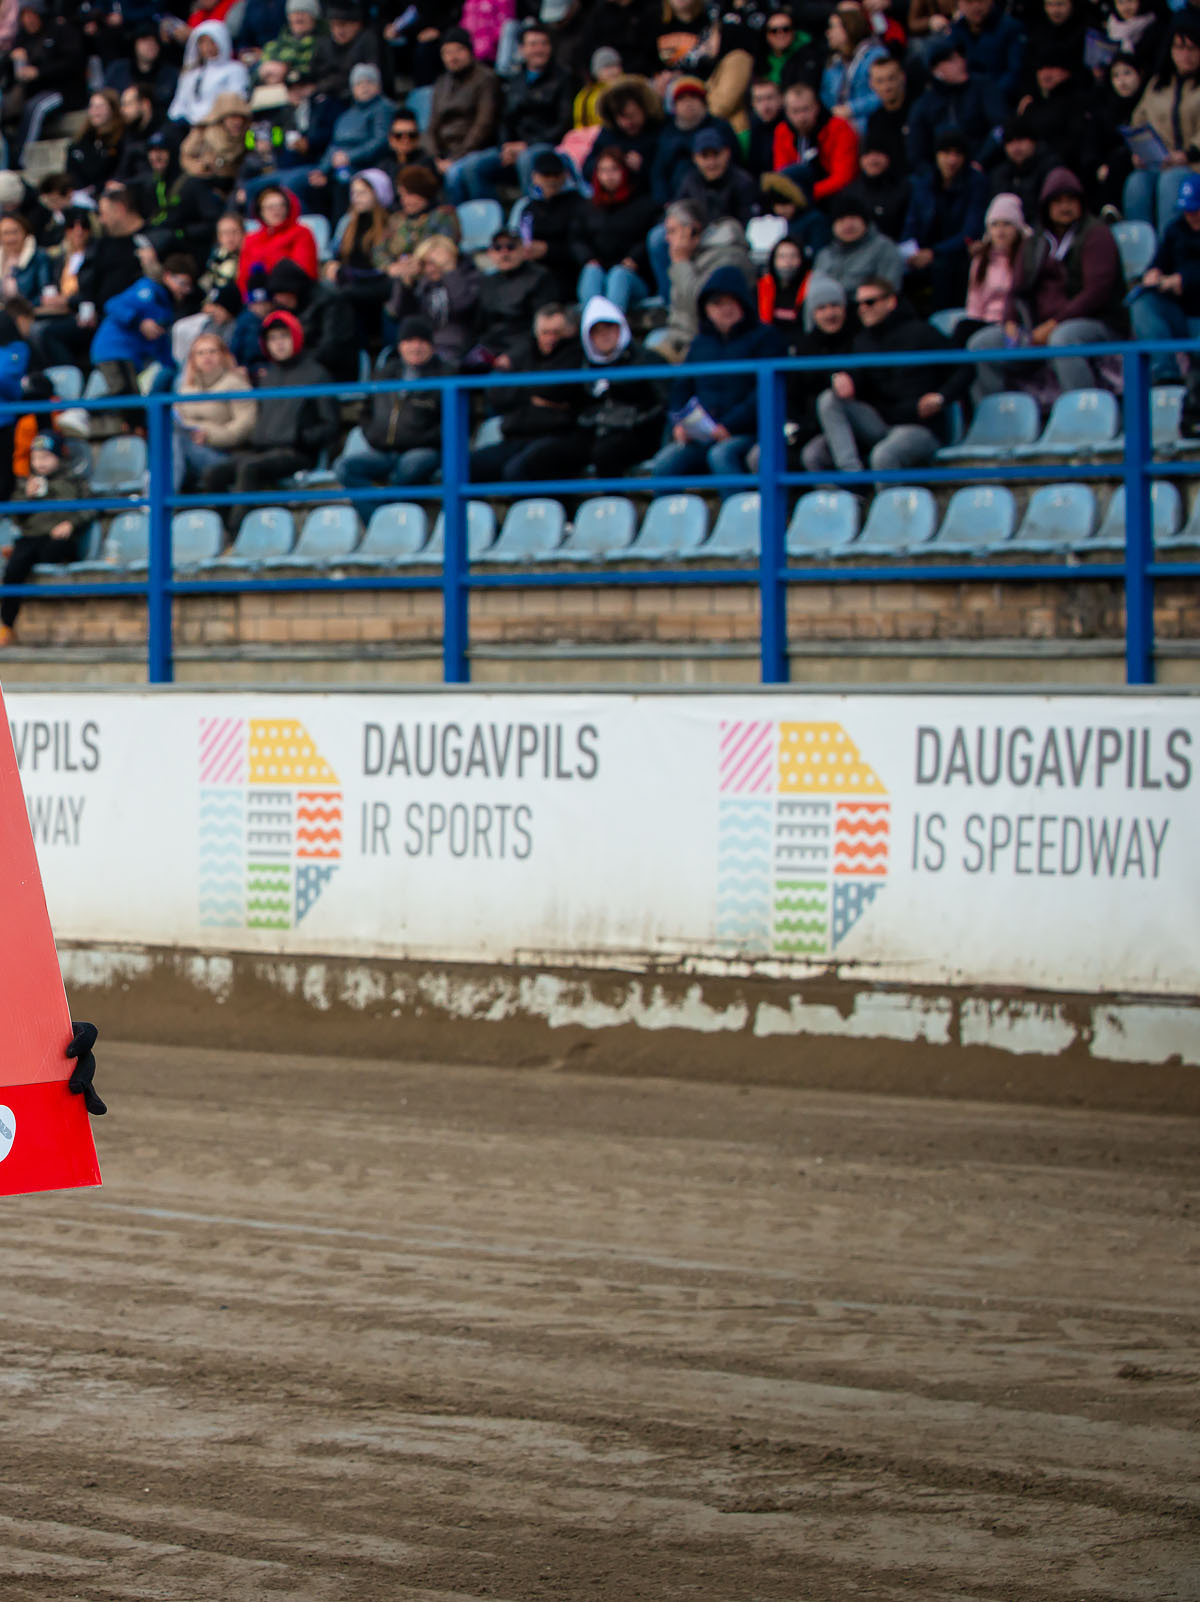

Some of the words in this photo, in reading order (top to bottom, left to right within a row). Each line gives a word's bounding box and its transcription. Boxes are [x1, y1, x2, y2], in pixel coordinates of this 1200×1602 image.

[363, 722, 600, 780] DAUGAVPILS
[915, 726, 1192, 791] DAUGAVPILS
[361, 801, 392, 856] IR
[404, 802, 534, 860] SPORTS
[912, 812, 947, 873] IS
[963, 813, 1170, 879] SPEEDWAY
